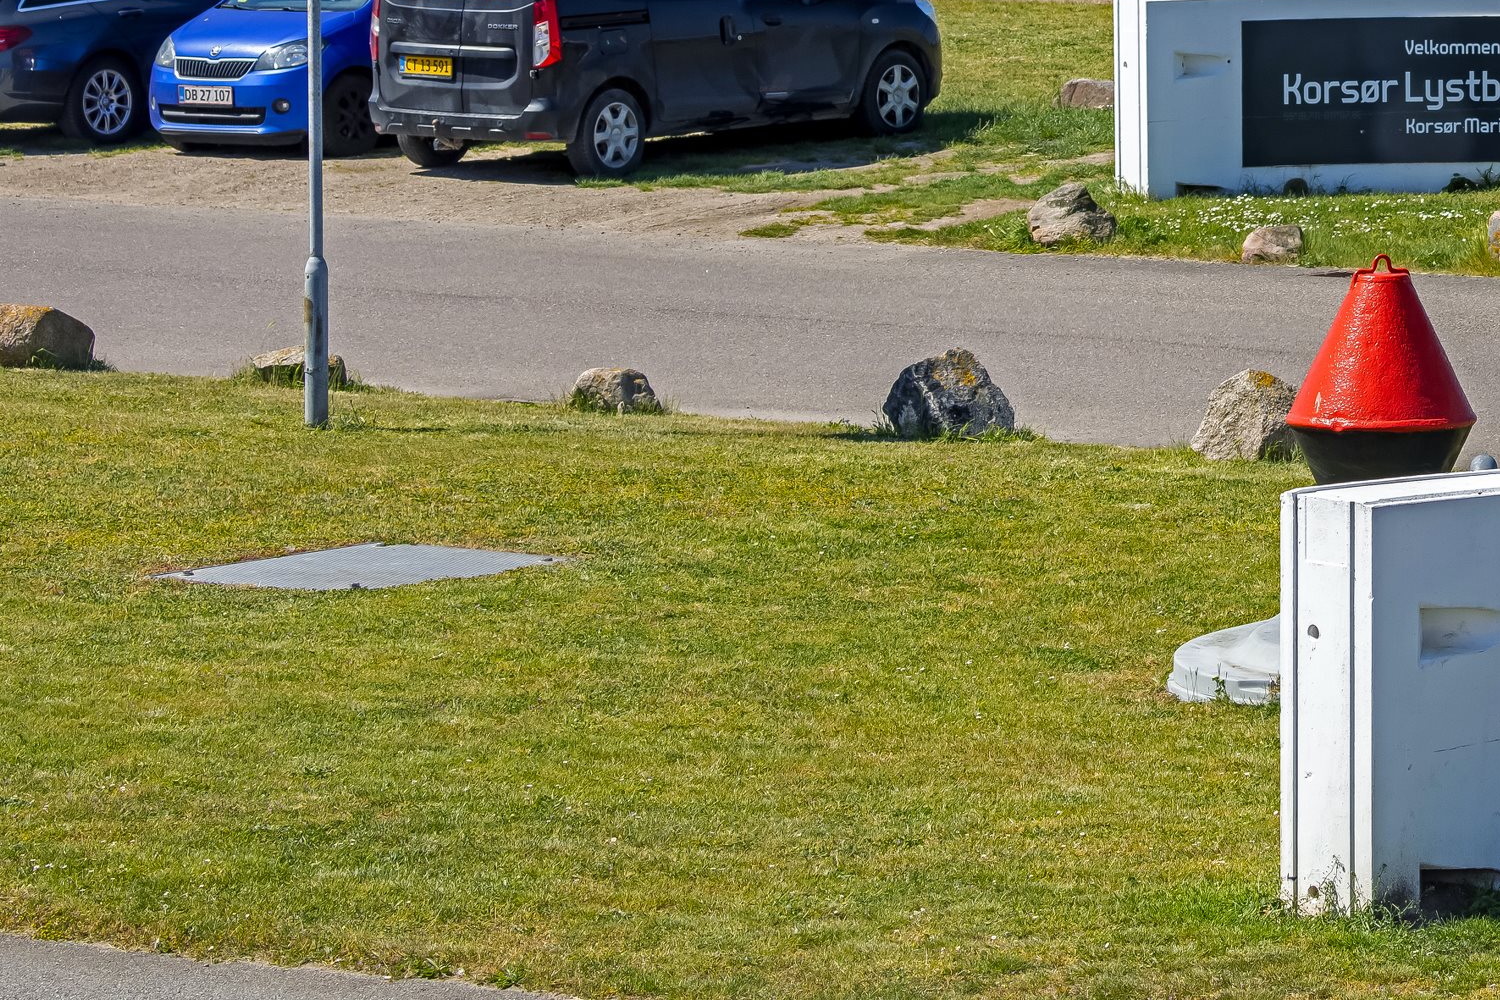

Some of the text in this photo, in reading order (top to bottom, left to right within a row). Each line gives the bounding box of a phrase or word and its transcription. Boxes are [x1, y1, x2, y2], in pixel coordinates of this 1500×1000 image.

[1405, 39, 1500, 55] Velkommen
[406, 58, 448, 73] CT 13 591
[185, 89, 230, 102] DB 27 107
[1283, 73, 1398, 105] Korsør
[1406, 118, 1461, 134] Korsør
